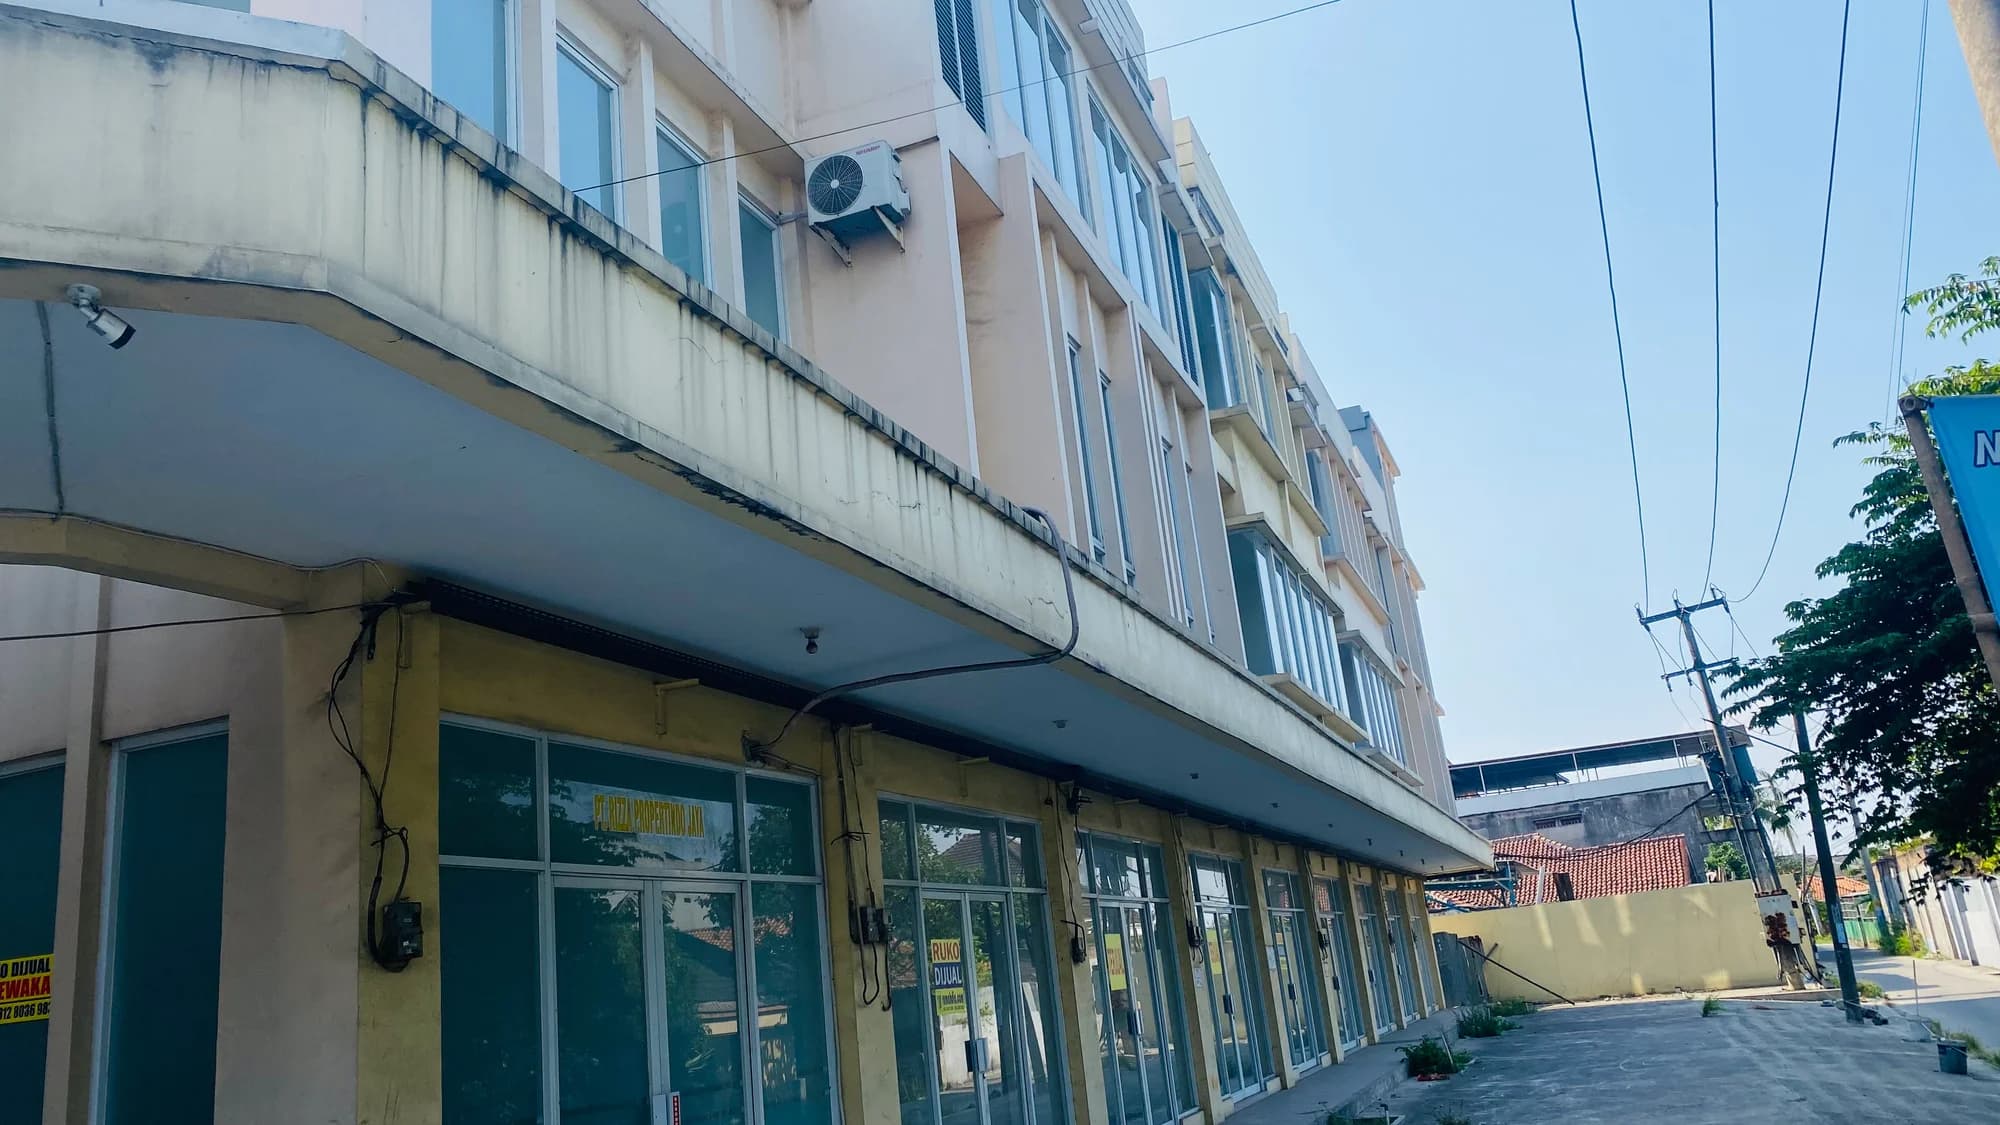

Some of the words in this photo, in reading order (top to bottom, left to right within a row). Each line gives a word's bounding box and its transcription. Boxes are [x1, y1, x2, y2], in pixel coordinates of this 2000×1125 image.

[933, 943, 960, 960] RUKO
[12, 957, 50, 976] DIJUAL
[934, 966, 962, 985] DIJUAL
